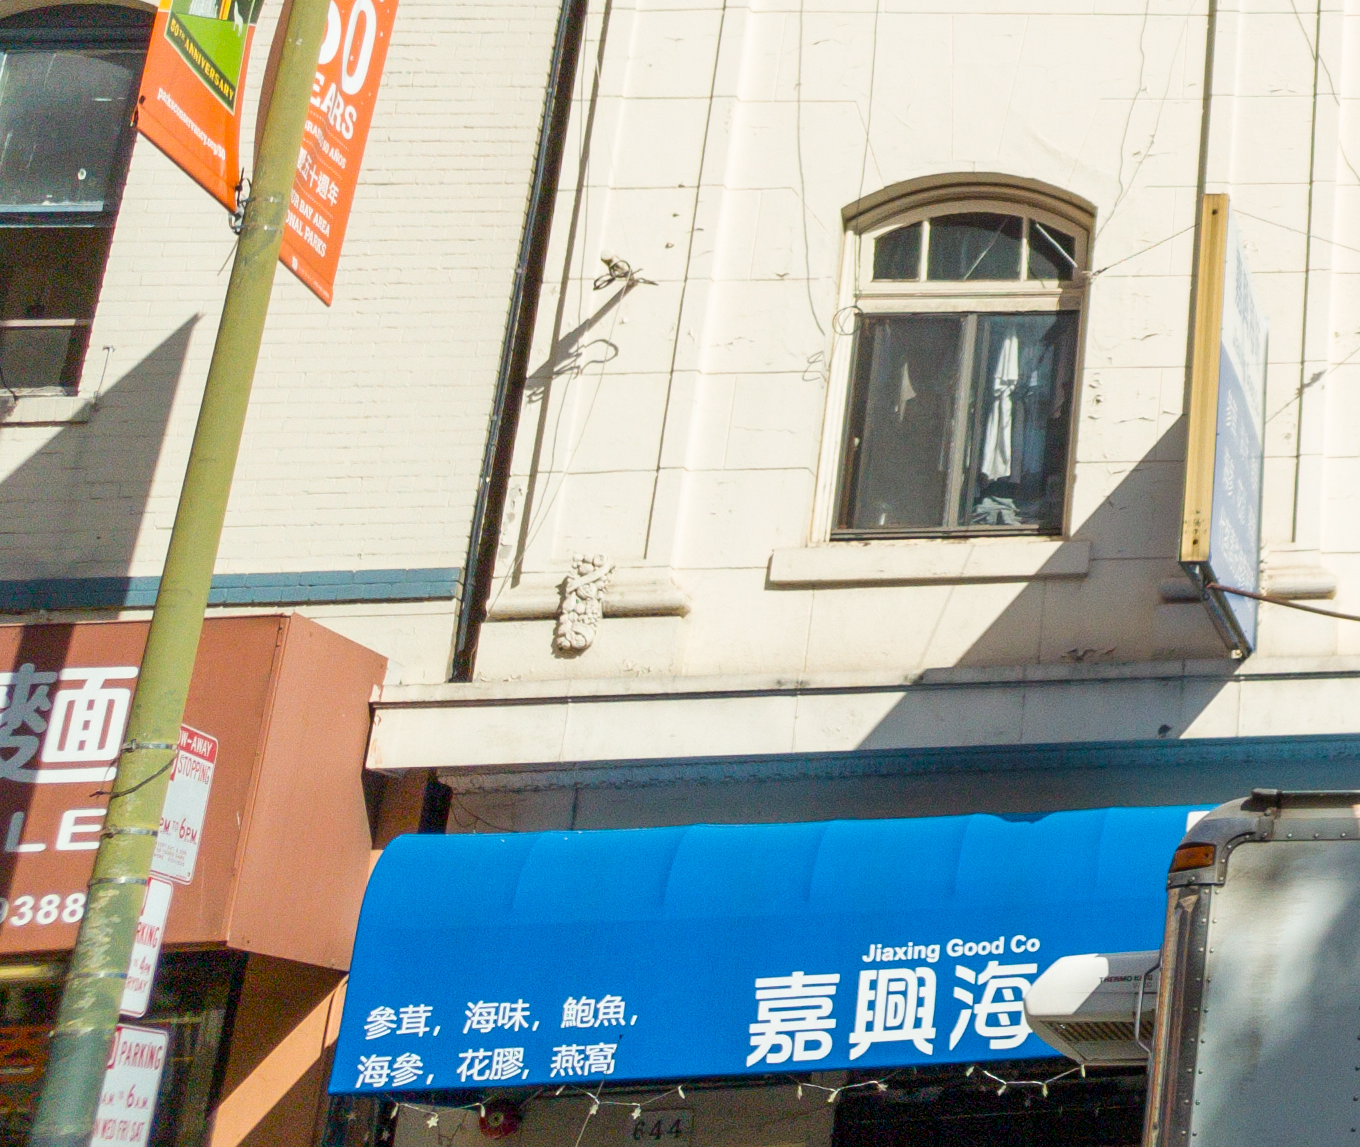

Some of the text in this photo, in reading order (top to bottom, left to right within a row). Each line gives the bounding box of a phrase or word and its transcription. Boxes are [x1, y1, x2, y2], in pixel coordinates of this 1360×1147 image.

[185, 38, 234, 101] ANNIVERSARY
[310, 71, 357, 140] EARS
[299, 198, 314, 219] BAY
[312, 213, 330, 237] AREA
[303, 225, 327, 257] PARKS
[177, 729, 213, 757] W-AWAY
[177, 754, 211, 785] STOPPING
[136, 921, 160, 949] RKING
[862, 934, 1041, 965] Jiaxing Good Co
[746, 960, 1038, 1068] 嘉興海
[118, 1040, 163, 1071] PARKING
[632, 1118, 682, 1142] 644
